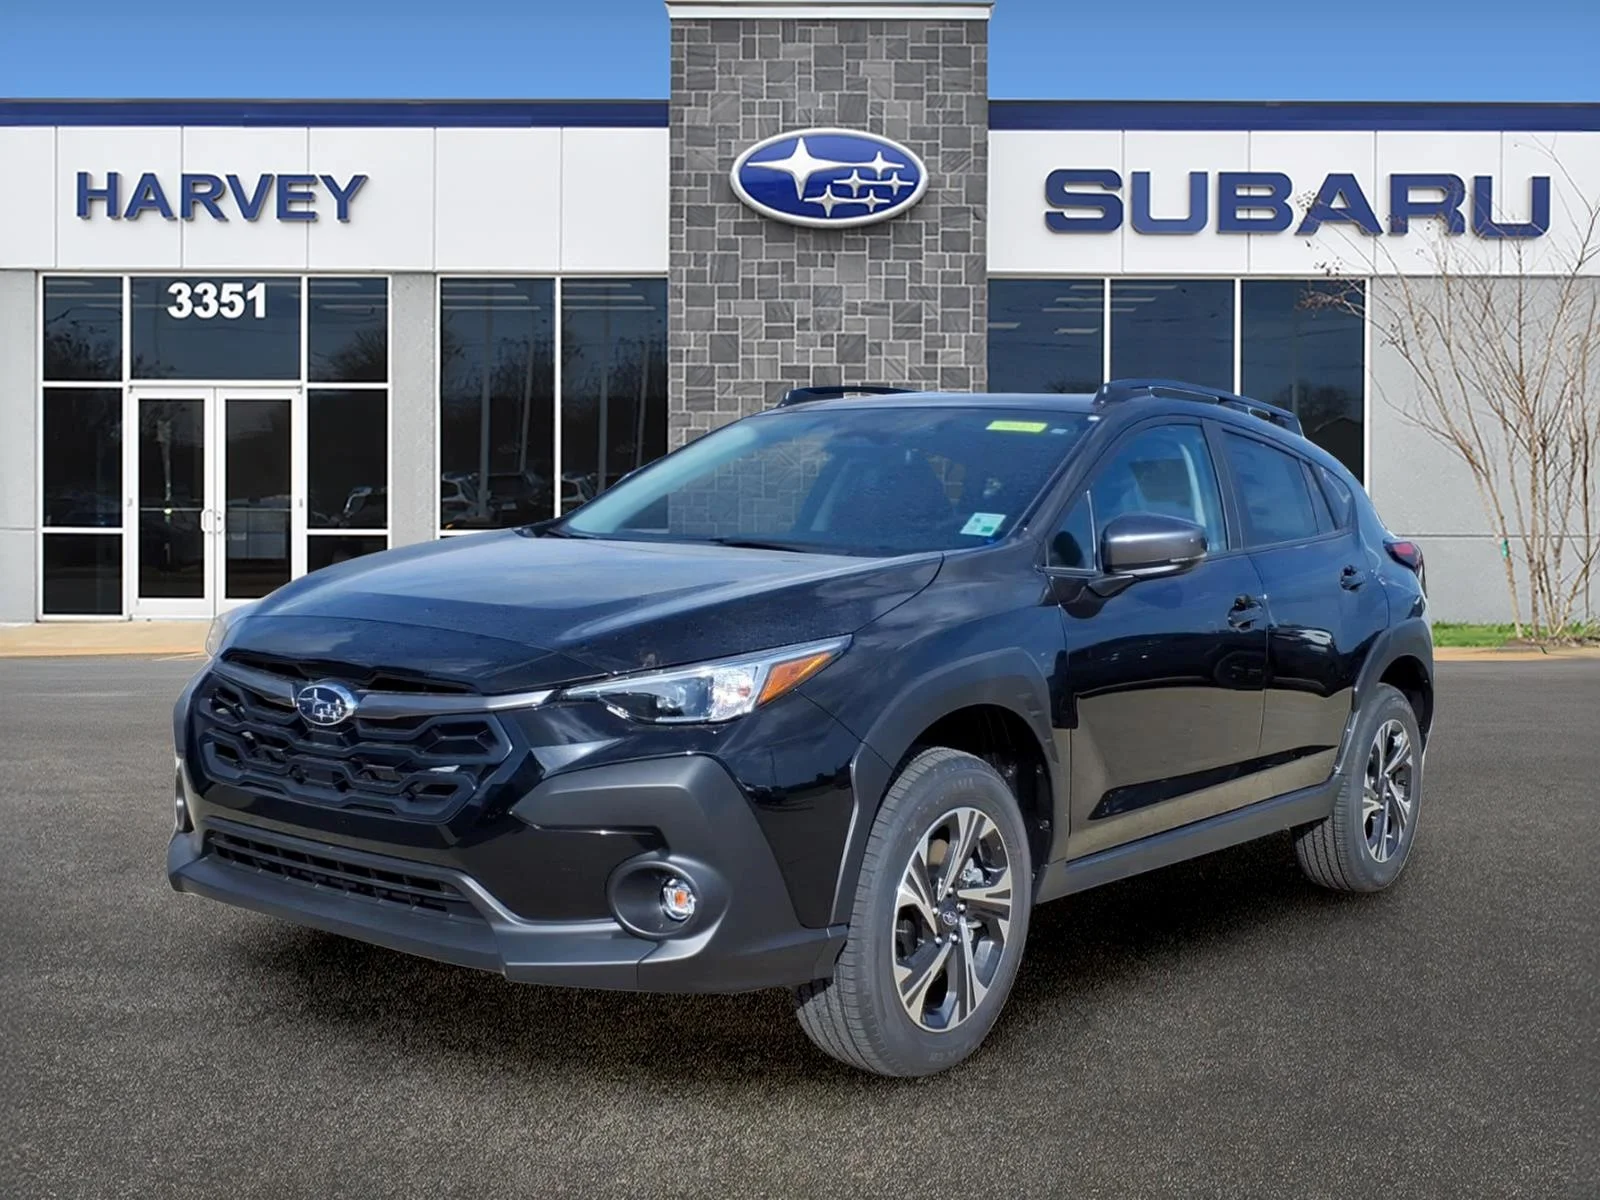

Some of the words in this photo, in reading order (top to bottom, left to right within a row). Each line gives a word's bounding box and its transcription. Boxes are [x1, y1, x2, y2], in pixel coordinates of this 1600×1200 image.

[77, 171, 368, 221] HARVEY
[1045, 169, 1551, 237] SUBARU
[167, 282, 266, 318] 3351
